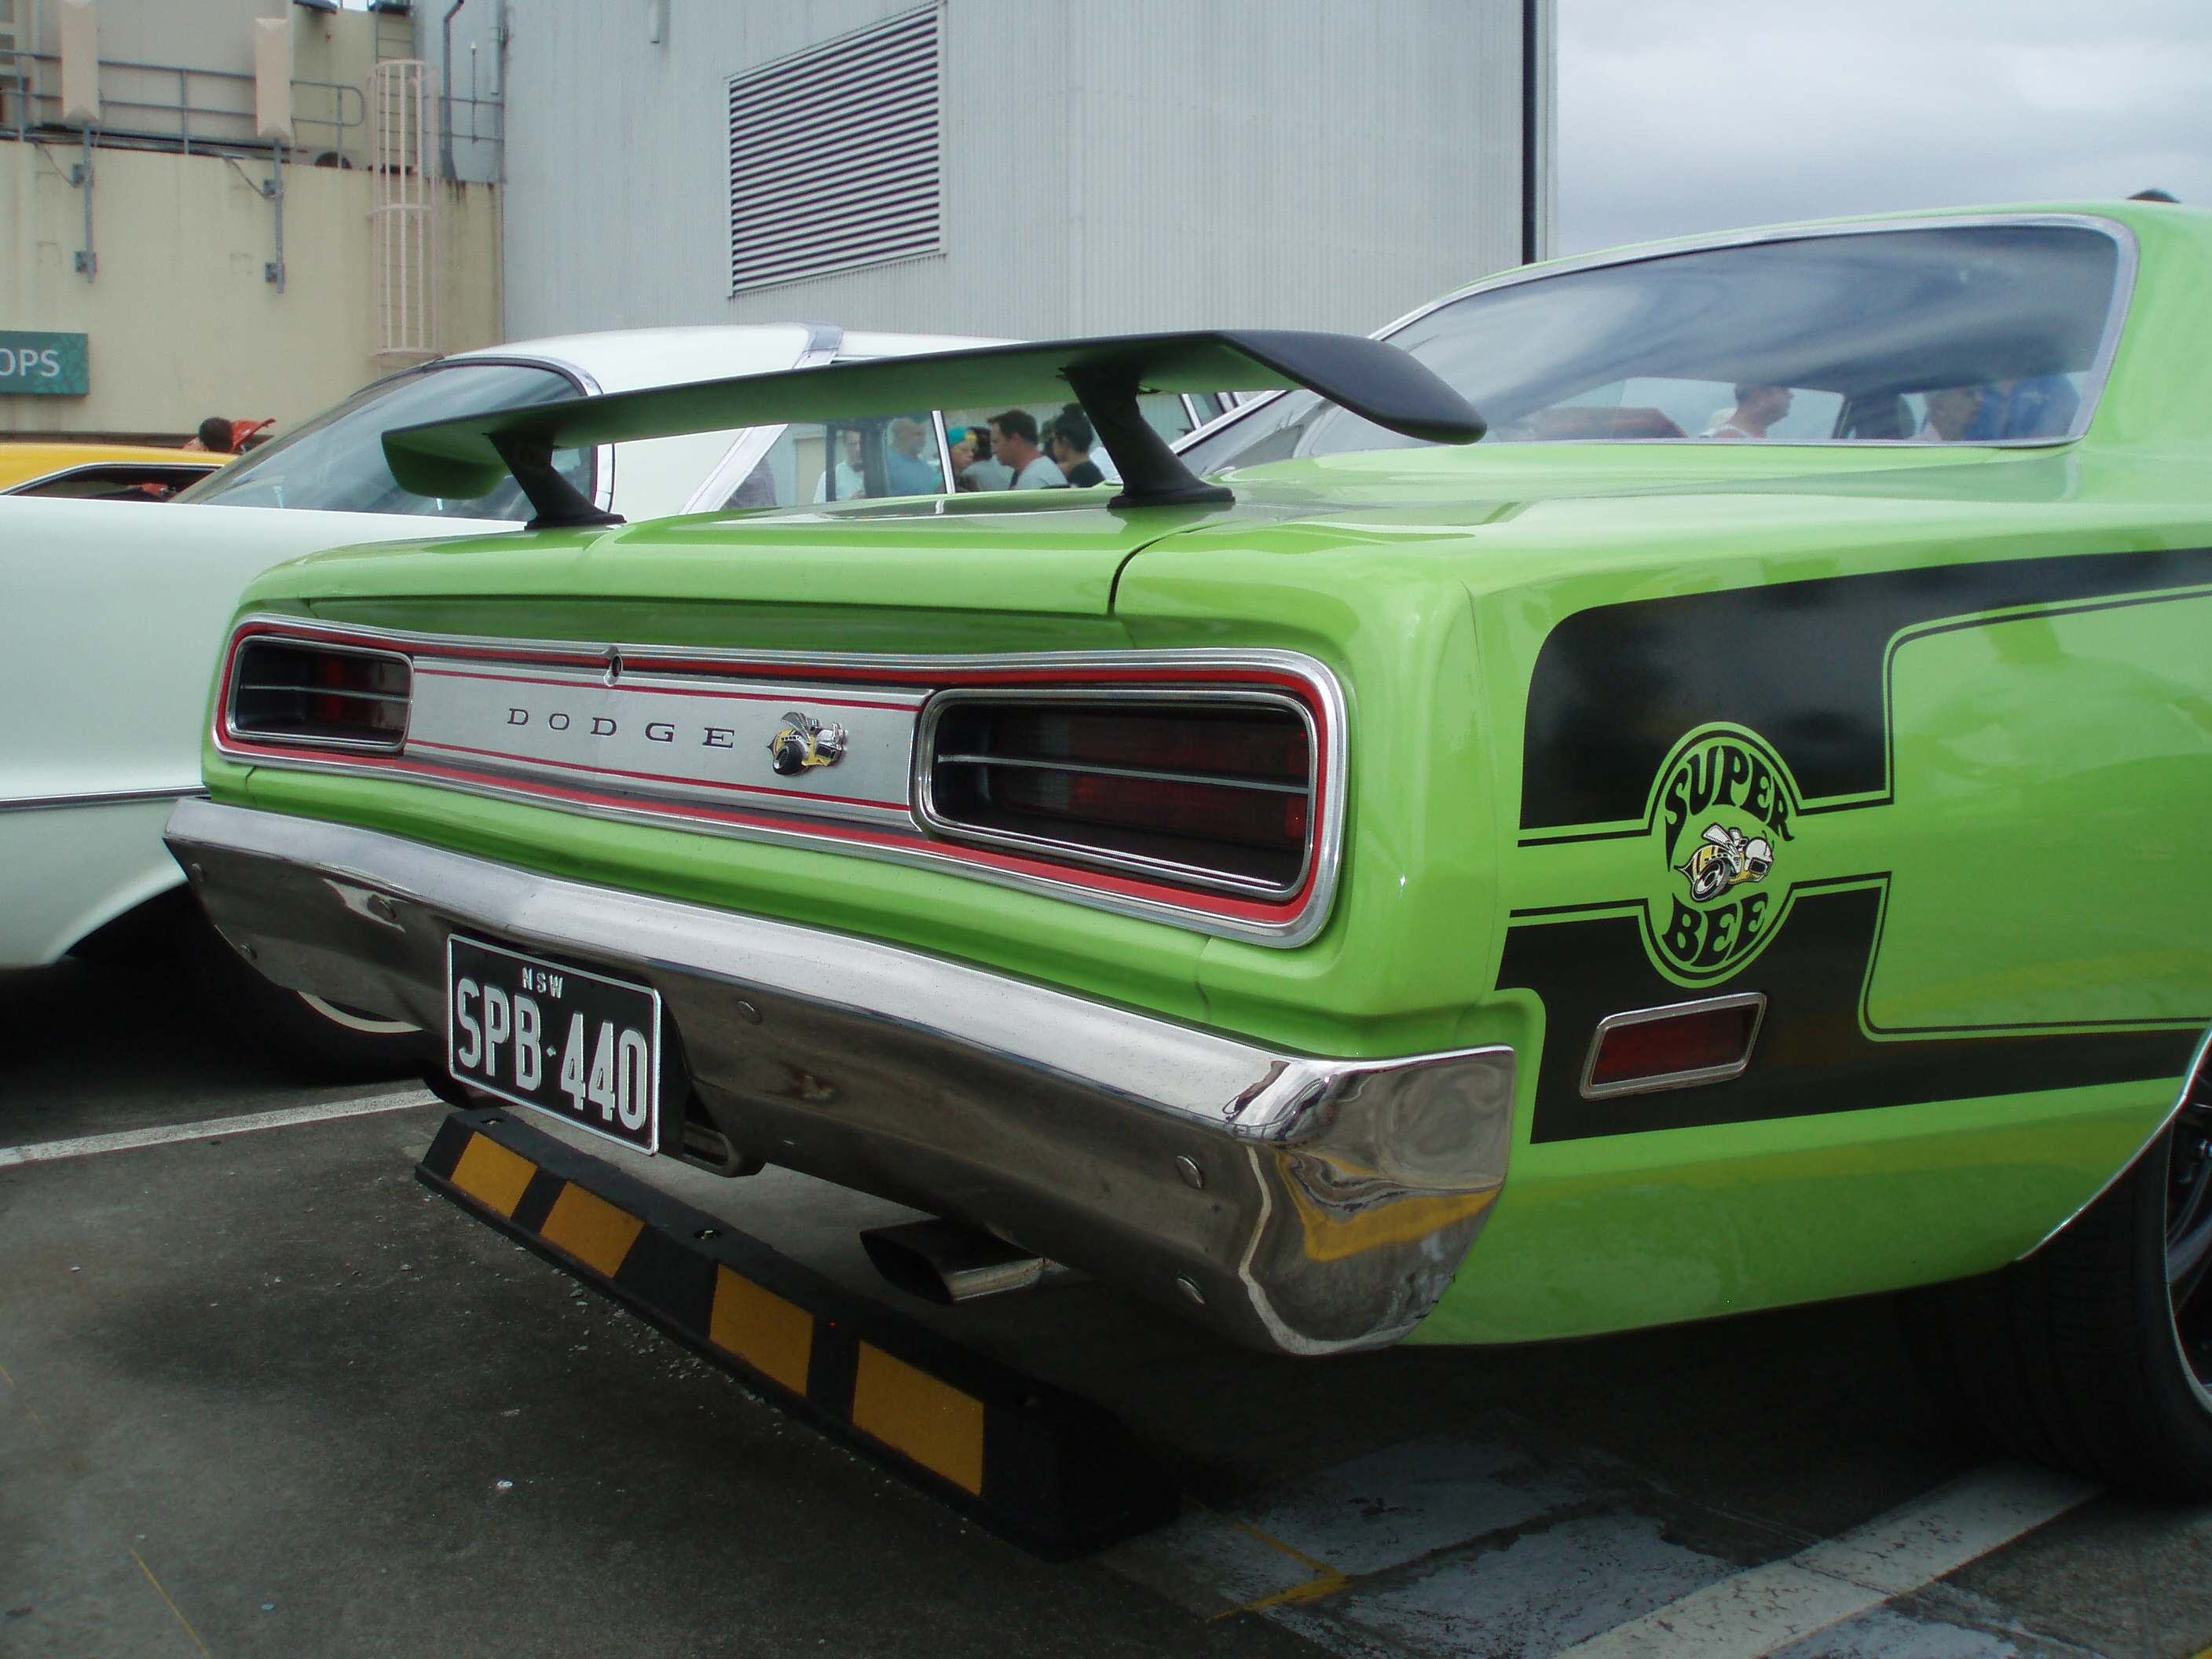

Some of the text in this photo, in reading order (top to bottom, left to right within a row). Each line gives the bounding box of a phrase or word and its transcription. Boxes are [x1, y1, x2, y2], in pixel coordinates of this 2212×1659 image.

[507, 708, 734, 749] DODGE
[1664, 745, 1795, 872] SUPER
[1661, 892, 1768, 966] BEE
[522, 966, 563, 998] NSW
